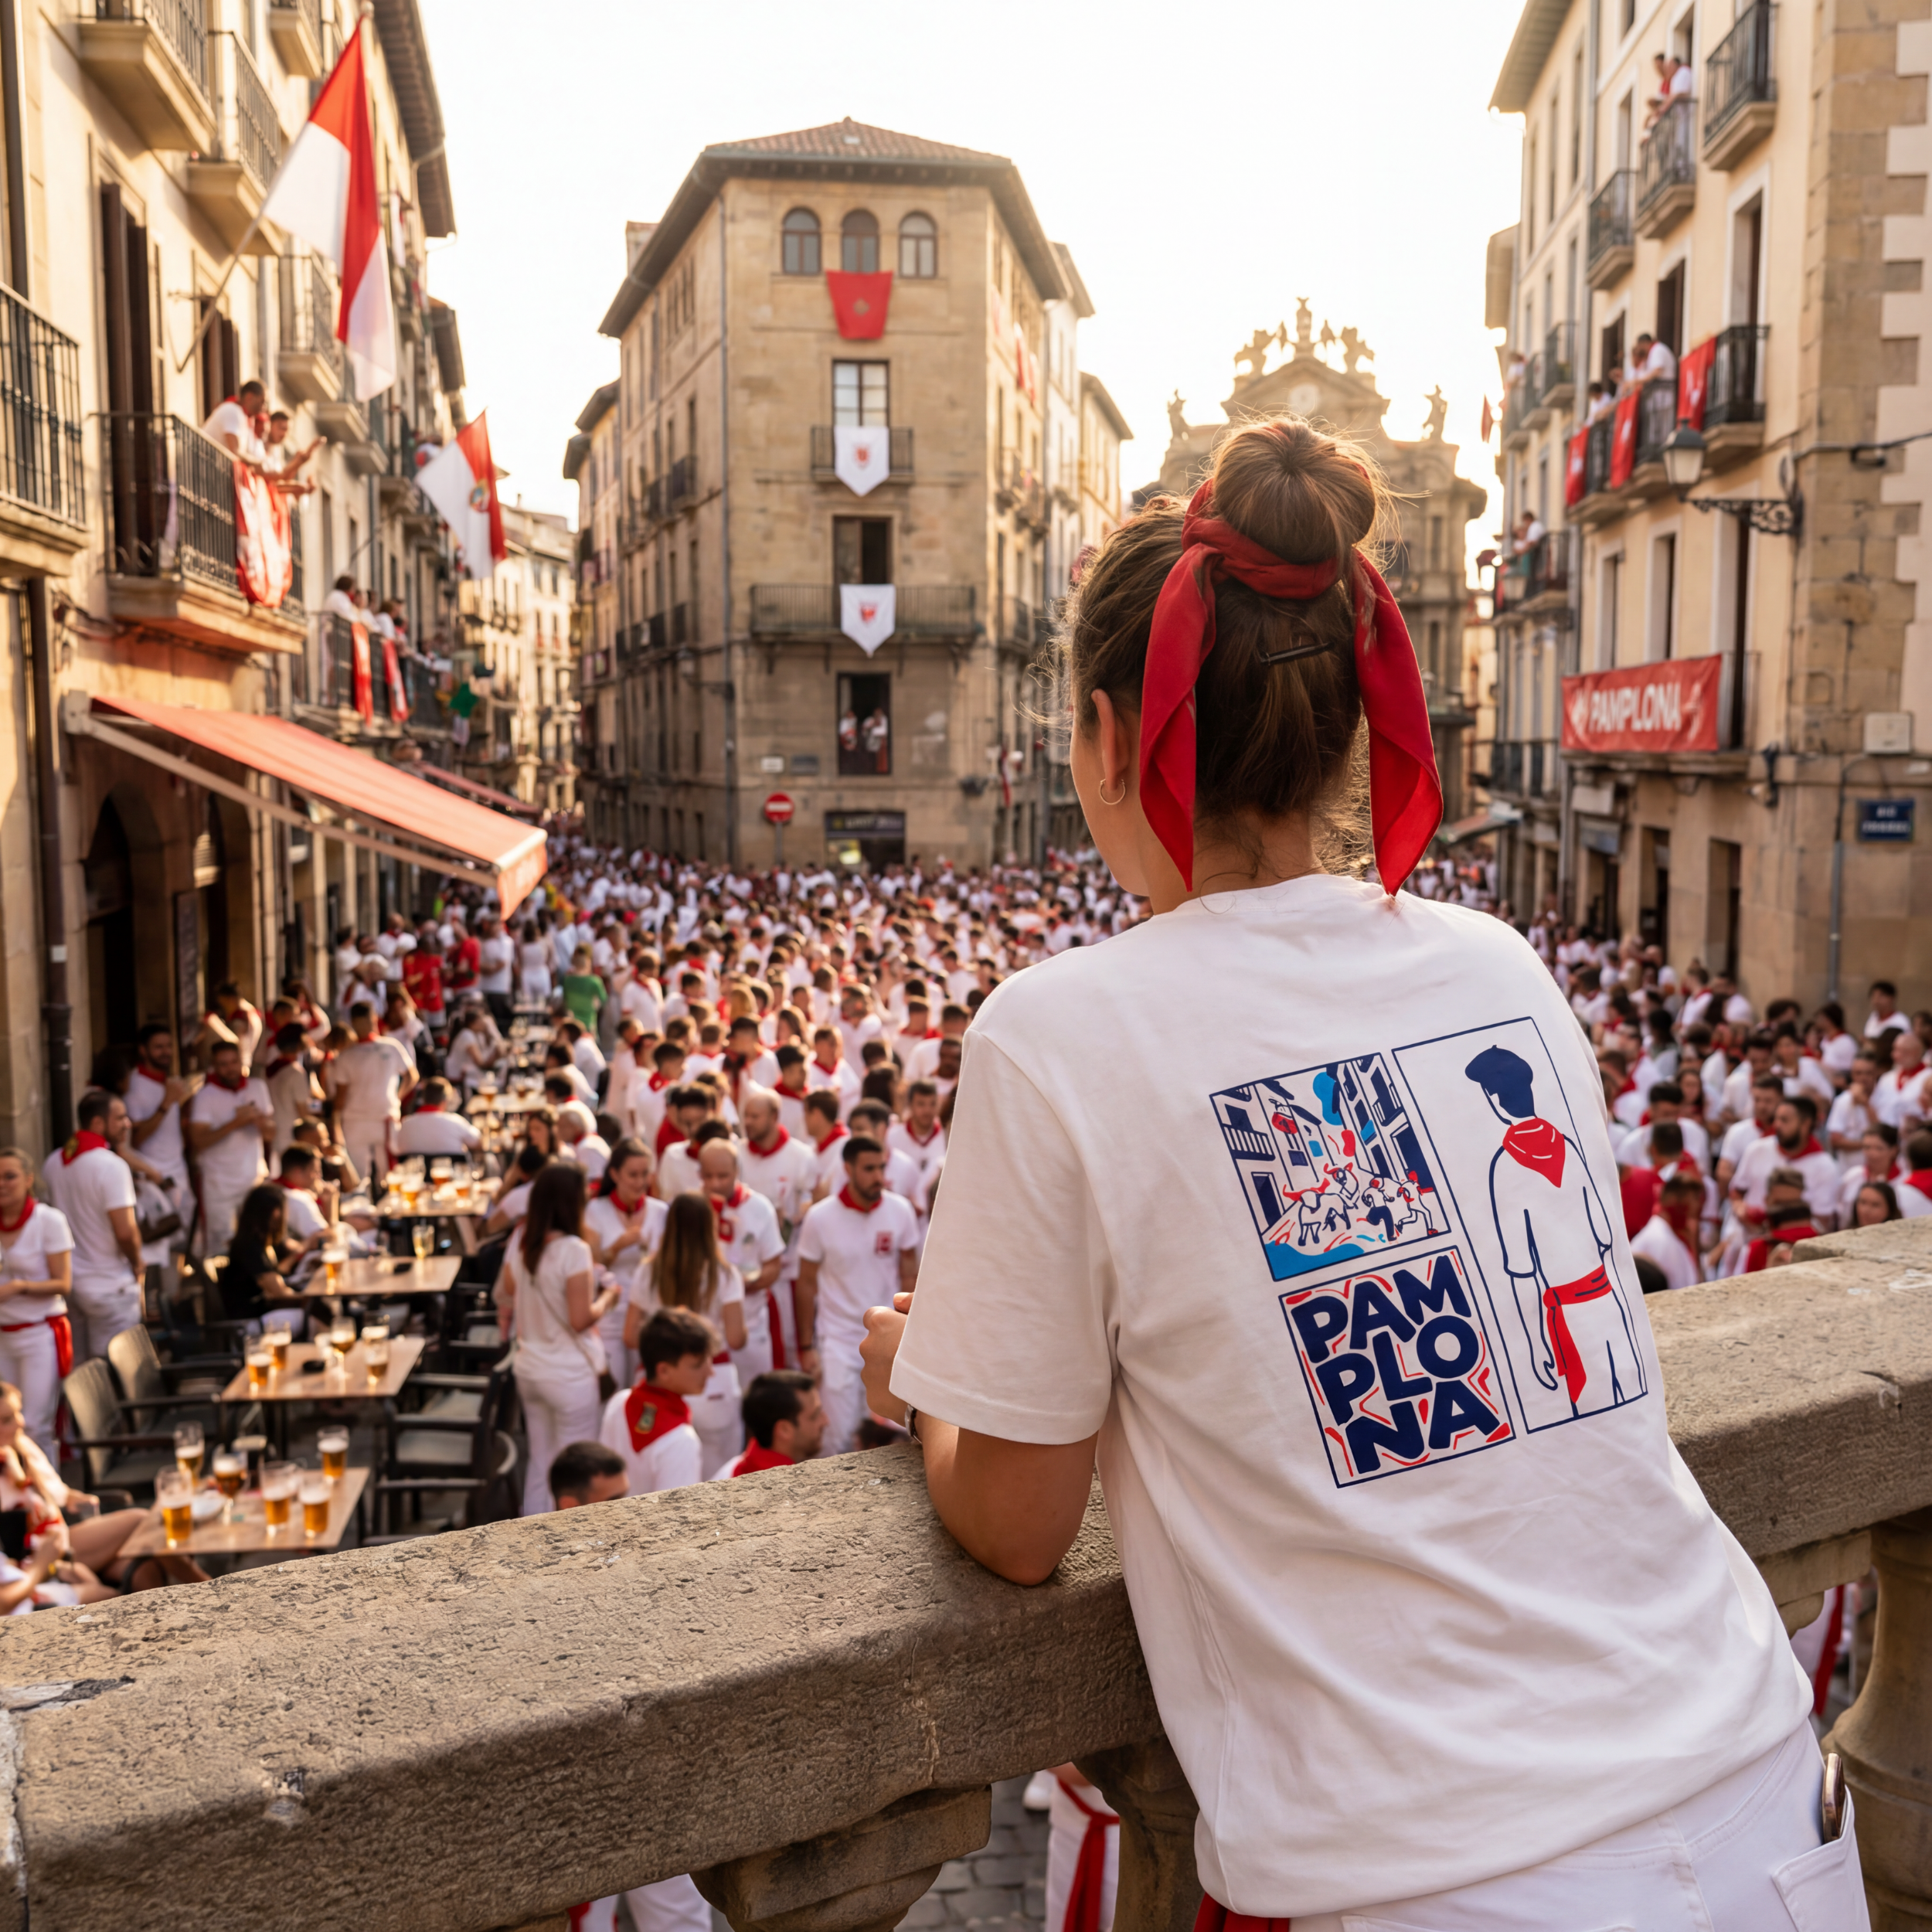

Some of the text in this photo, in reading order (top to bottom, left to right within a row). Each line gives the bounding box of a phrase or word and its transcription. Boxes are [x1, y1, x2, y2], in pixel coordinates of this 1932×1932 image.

[1590, 682, 1682, 733] PAMPLONA
[1291, 1255, 1472, 1364] PAM
[1315, 1315, 1479, 1427] PLO
[1345, 1379, 1501, 1475] NA
